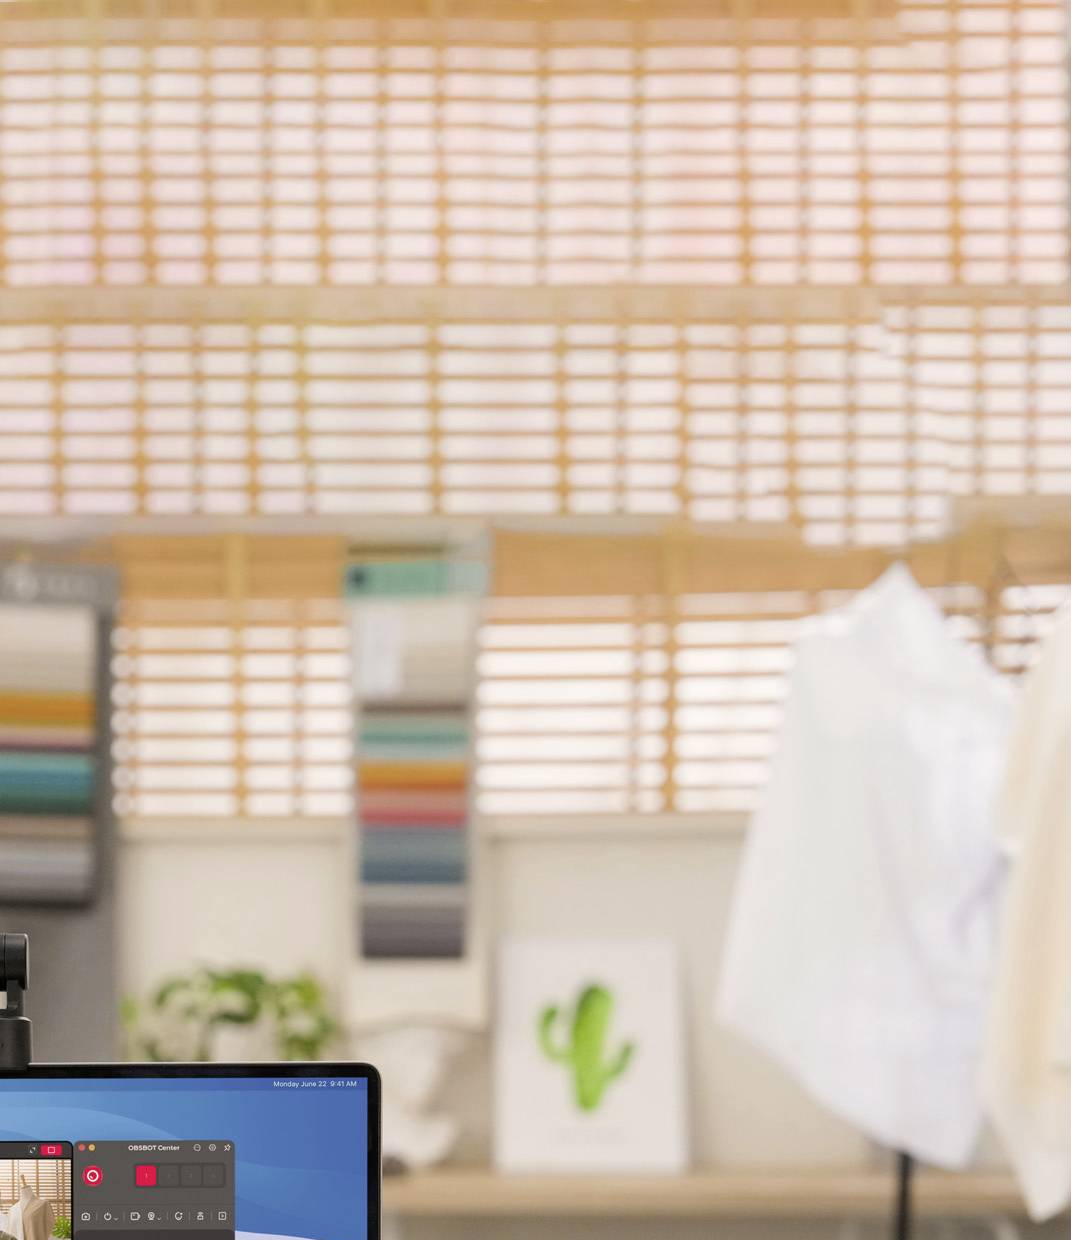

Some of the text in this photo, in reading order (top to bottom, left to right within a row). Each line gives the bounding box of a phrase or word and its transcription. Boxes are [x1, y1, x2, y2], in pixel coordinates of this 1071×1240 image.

[273, 1080, 357, 1089] Monday June 22 9:41 AM
